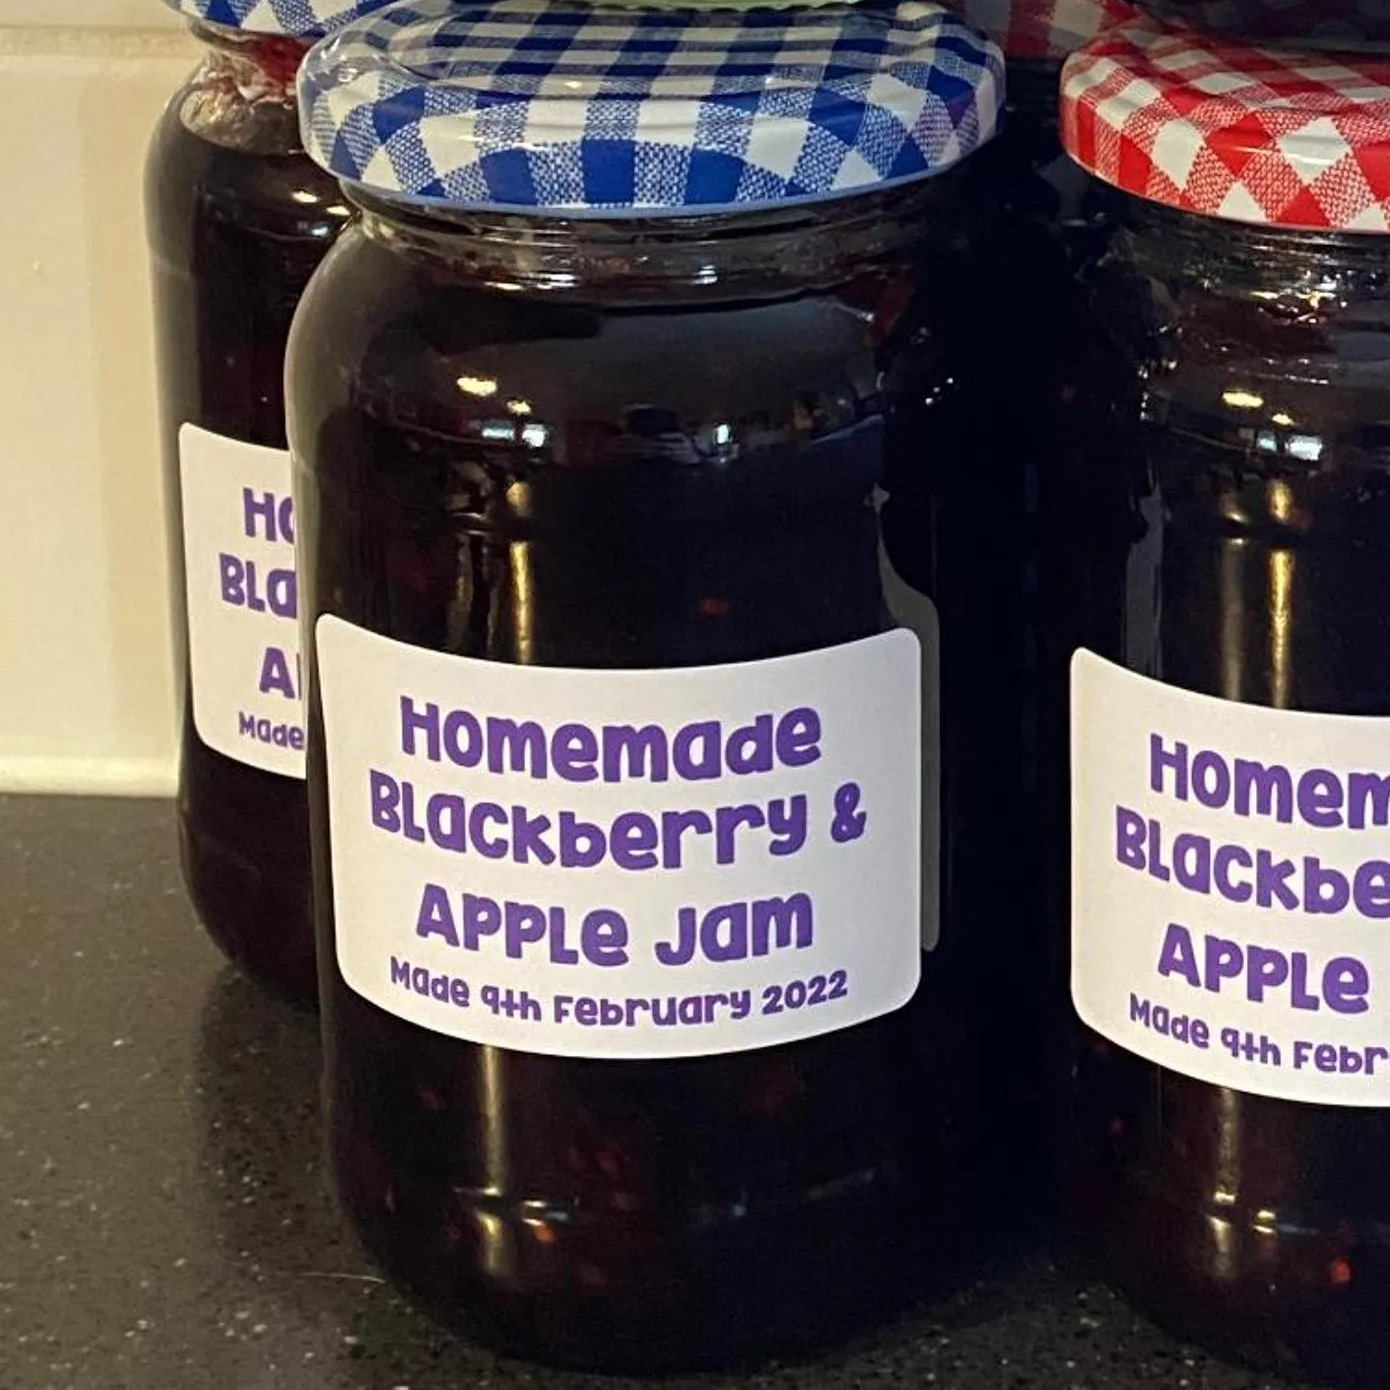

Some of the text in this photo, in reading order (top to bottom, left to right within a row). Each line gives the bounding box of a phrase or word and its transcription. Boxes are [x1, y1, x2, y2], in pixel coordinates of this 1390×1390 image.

[239, 711, 305, 750] Made
[403, 695, 820, 782] Homemade
[830, 782, 867, 843] &
[655, 893, 813, 966] Jam
[393, 956, 848, 1028] Made 9th February 2022
[1132, 994, 1208, 1047] Made
[1222, 1026, 1280, 1063] 9th
